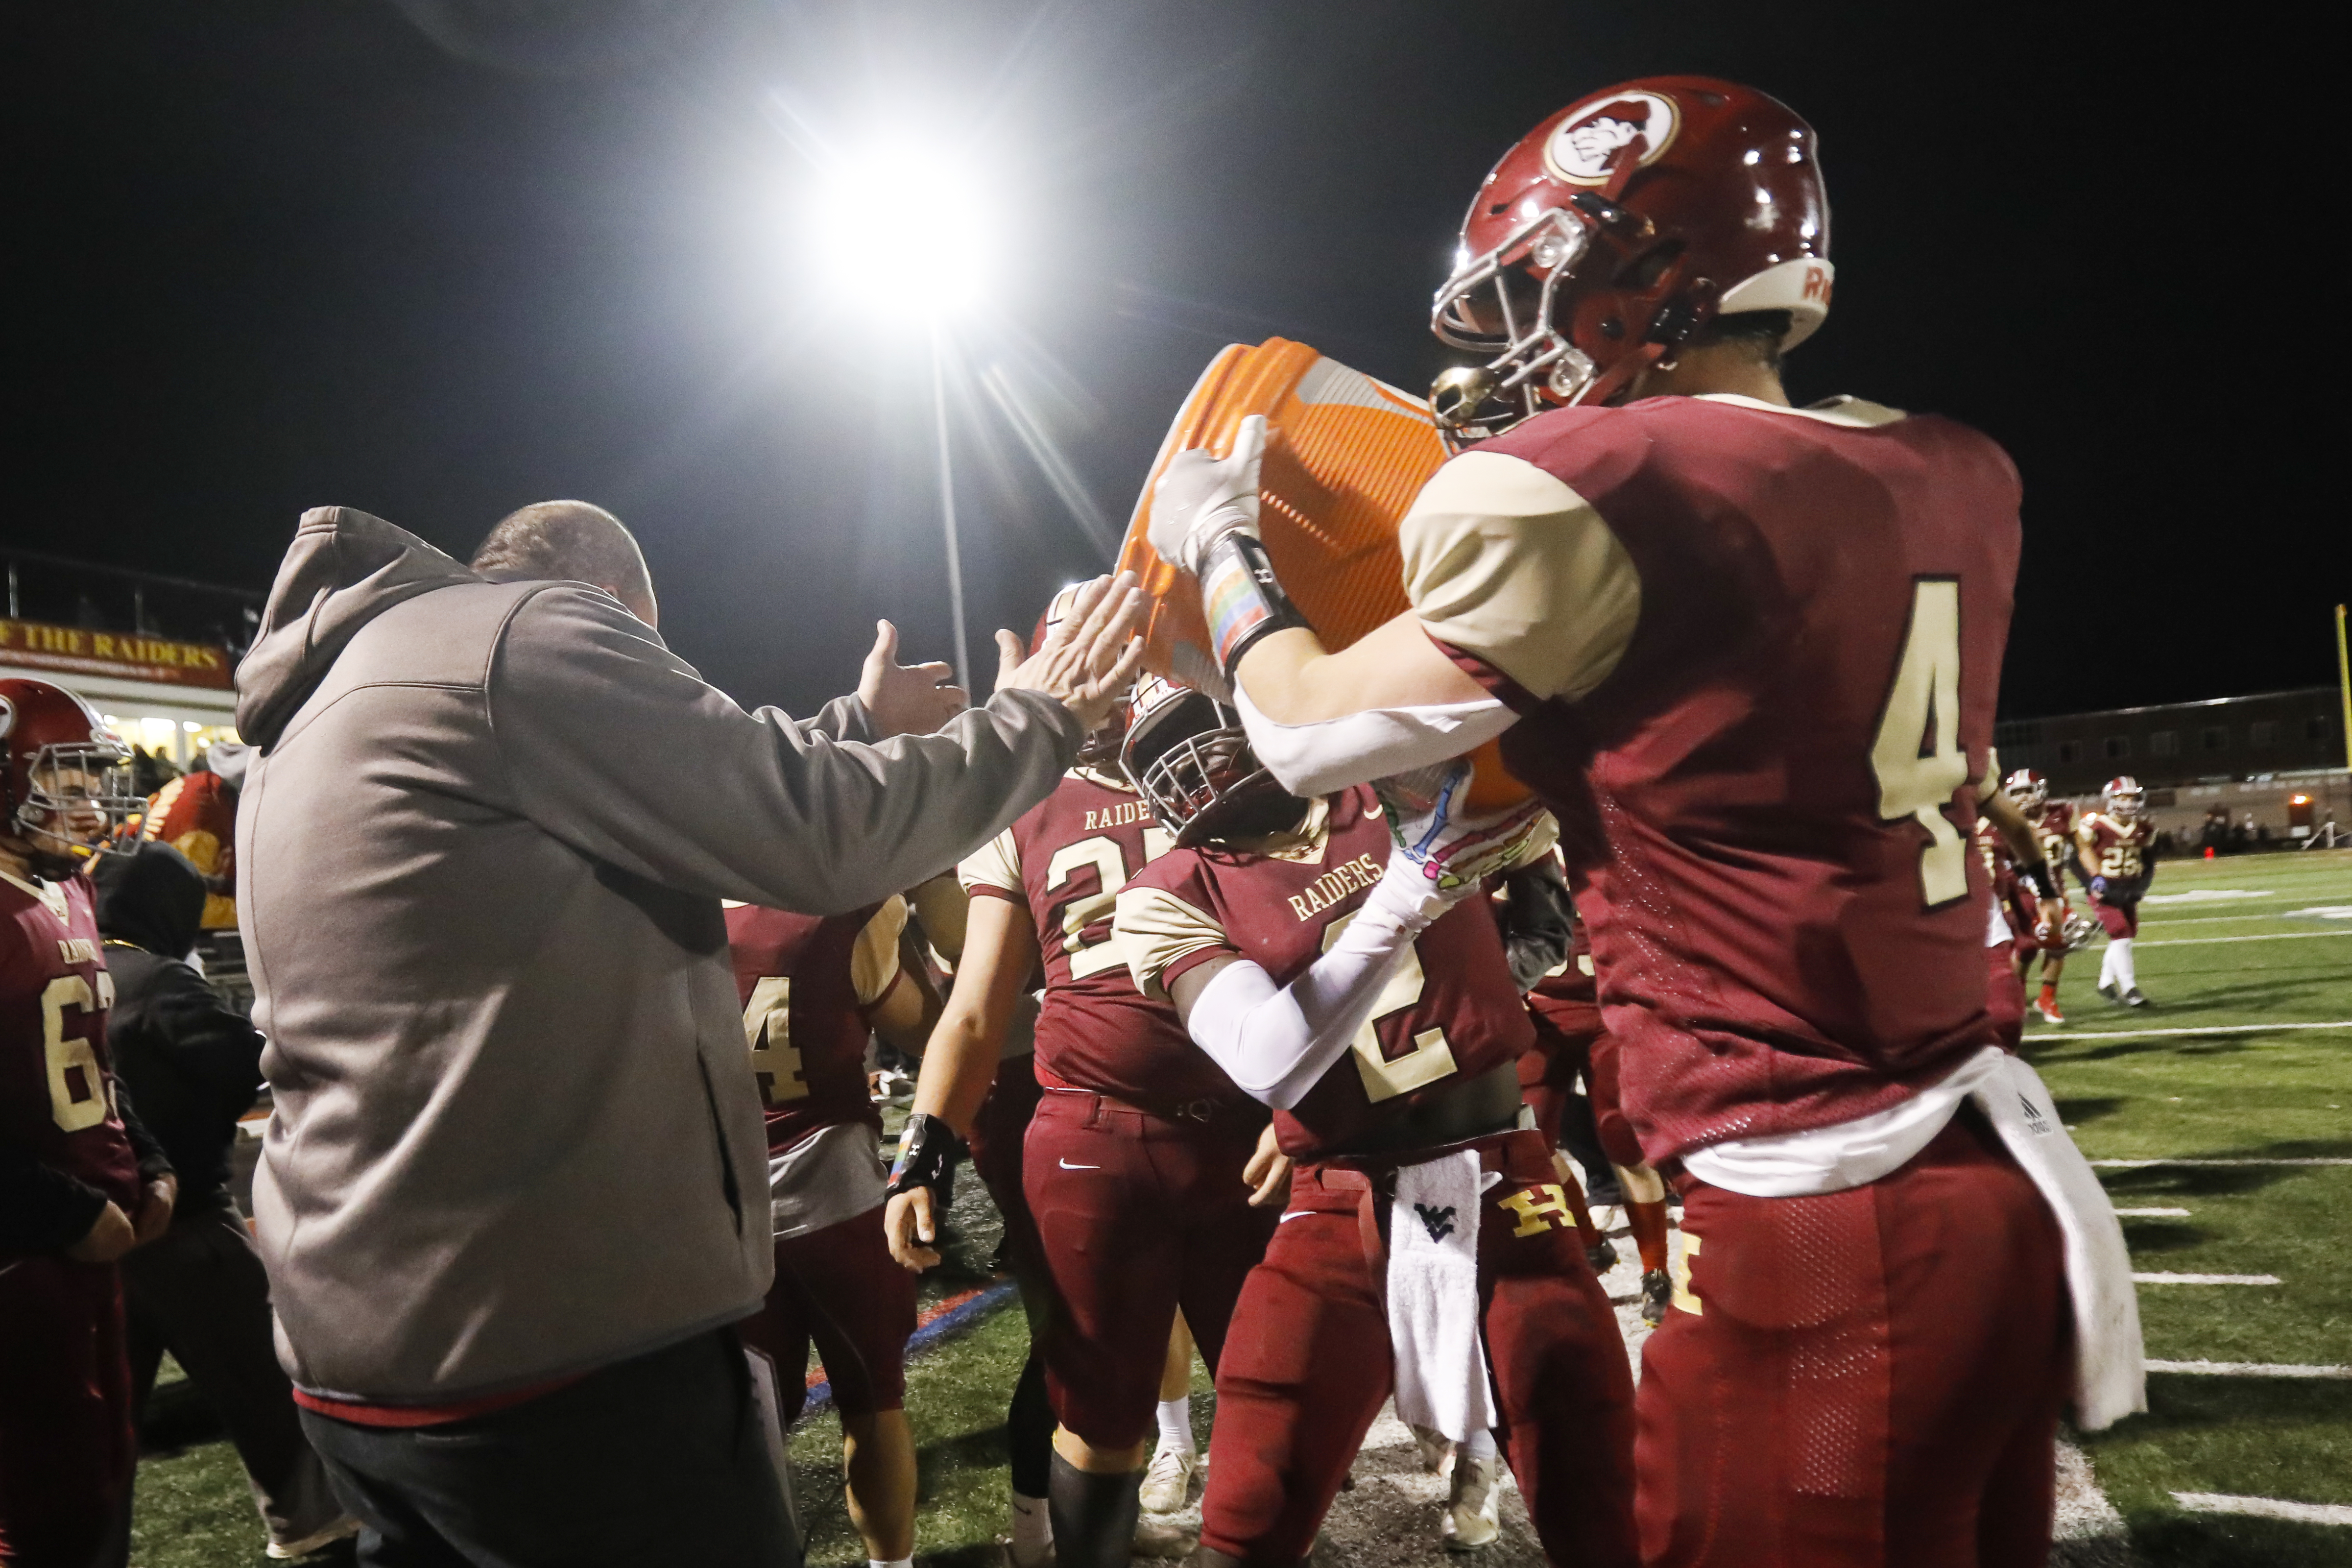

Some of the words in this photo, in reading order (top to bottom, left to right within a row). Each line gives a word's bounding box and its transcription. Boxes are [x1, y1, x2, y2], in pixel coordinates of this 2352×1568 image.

[24, 624, 82, 654] THE
[93, 633, 219, 669] RAIDERS
[1872, 580, 1968, 906] 4
[1288, 853, 1385, 921] RAIDERS
[1498, 1184, 1578, 1238] H
